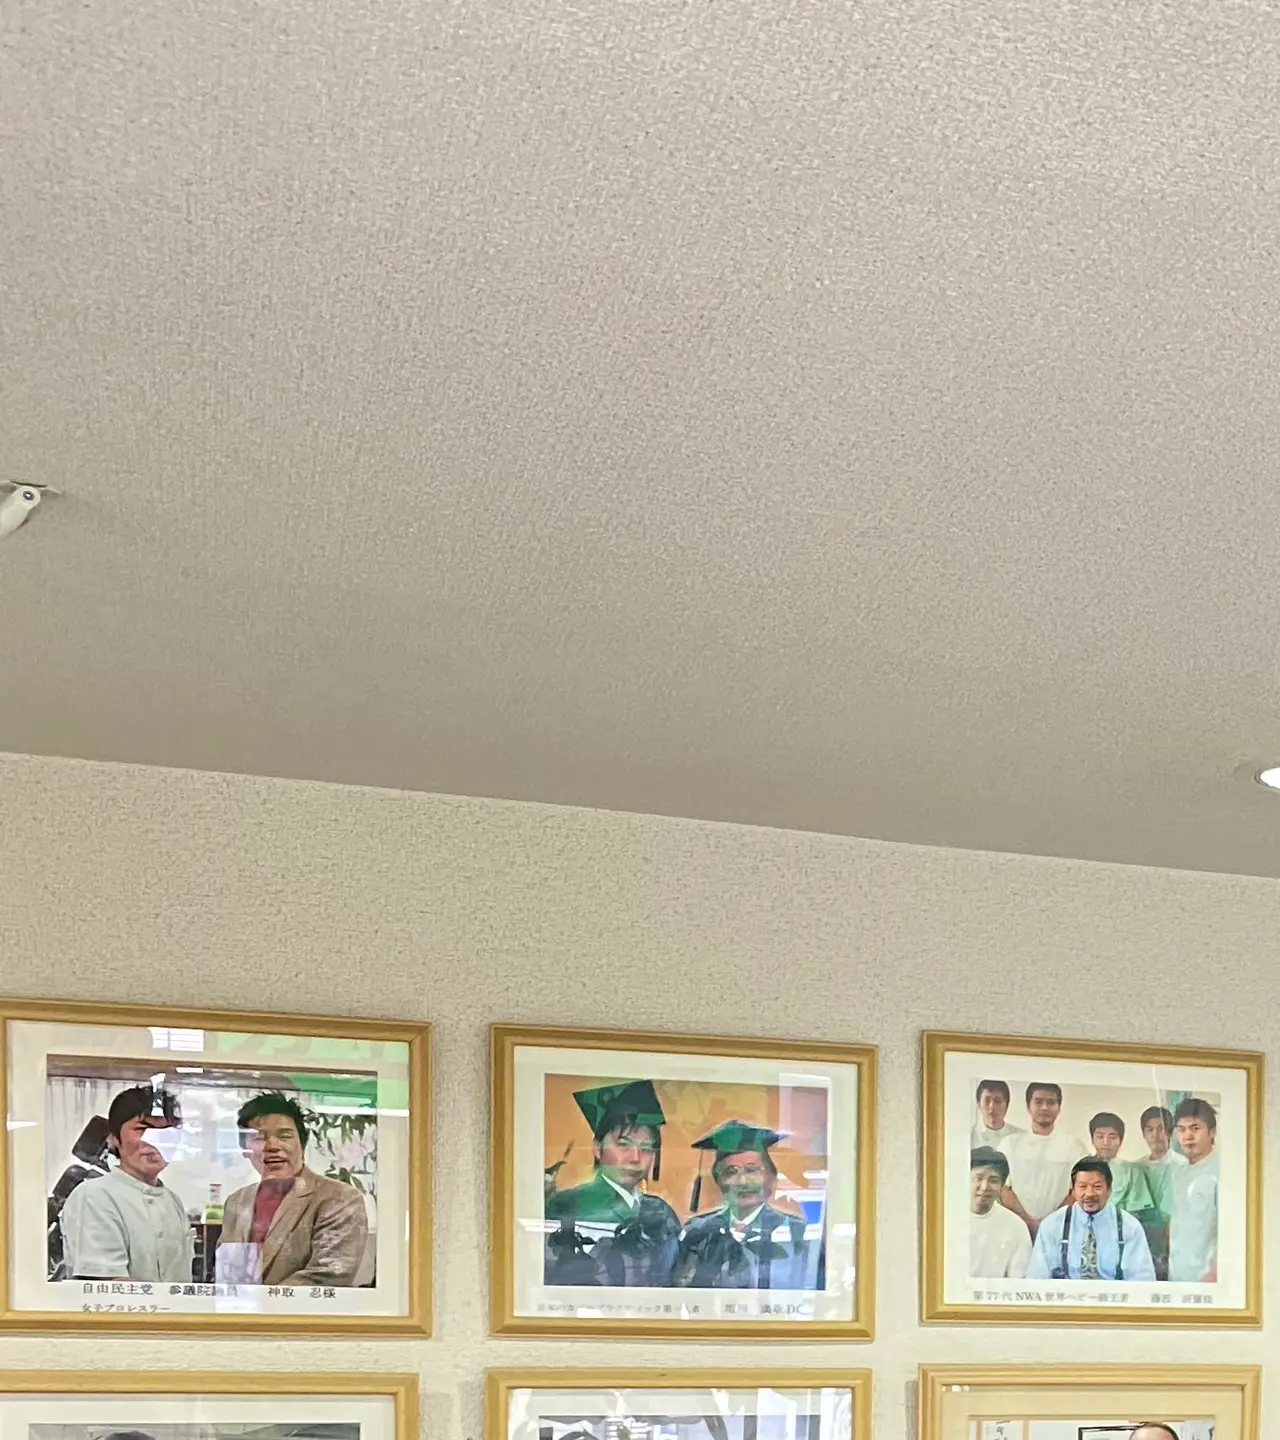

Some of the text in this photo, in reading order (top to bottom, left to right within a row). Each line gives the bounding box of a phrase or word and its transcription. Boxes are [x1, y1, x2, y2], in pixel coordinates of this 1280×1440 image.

[82, 1283, 153, 1295] 自由民主党
[268, 1287, 295, 1298] 神取
